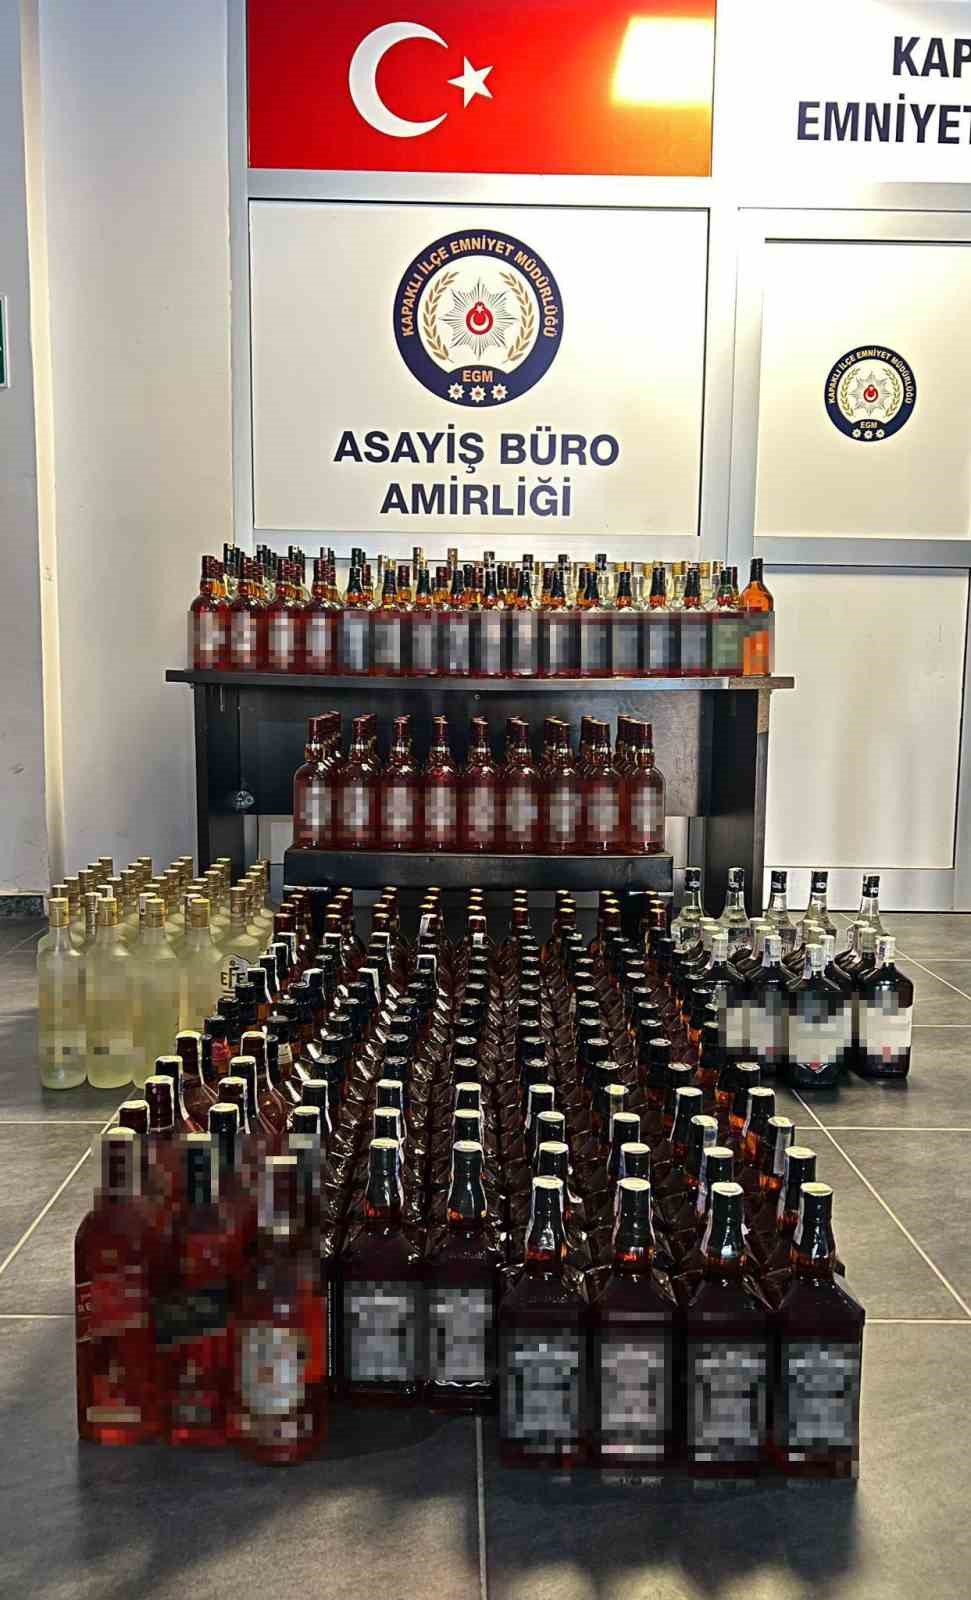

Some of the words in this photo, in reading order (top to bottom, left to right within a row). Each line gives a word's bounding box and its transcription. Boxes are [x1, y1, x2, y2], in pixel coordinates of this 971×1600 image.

[400, 273, 423, 337] KAPAKLI
[417, 246, 450, 275] İLÇE
[449, 234, 516, 257] EMNİYET
[513, 251, 560, 338] MÜDÜRLÜĞÜ
[856, 347, 892, 360] EMNİYET
[462, 370, 494, 383] EGM
[860, 421, 878, 429] EGM
[333, 423, 485, 474] ASAYİŞ
[500, 426, 620, 466] BÜRO
[380, 475, 572, 517] AMİRLİĞİ
